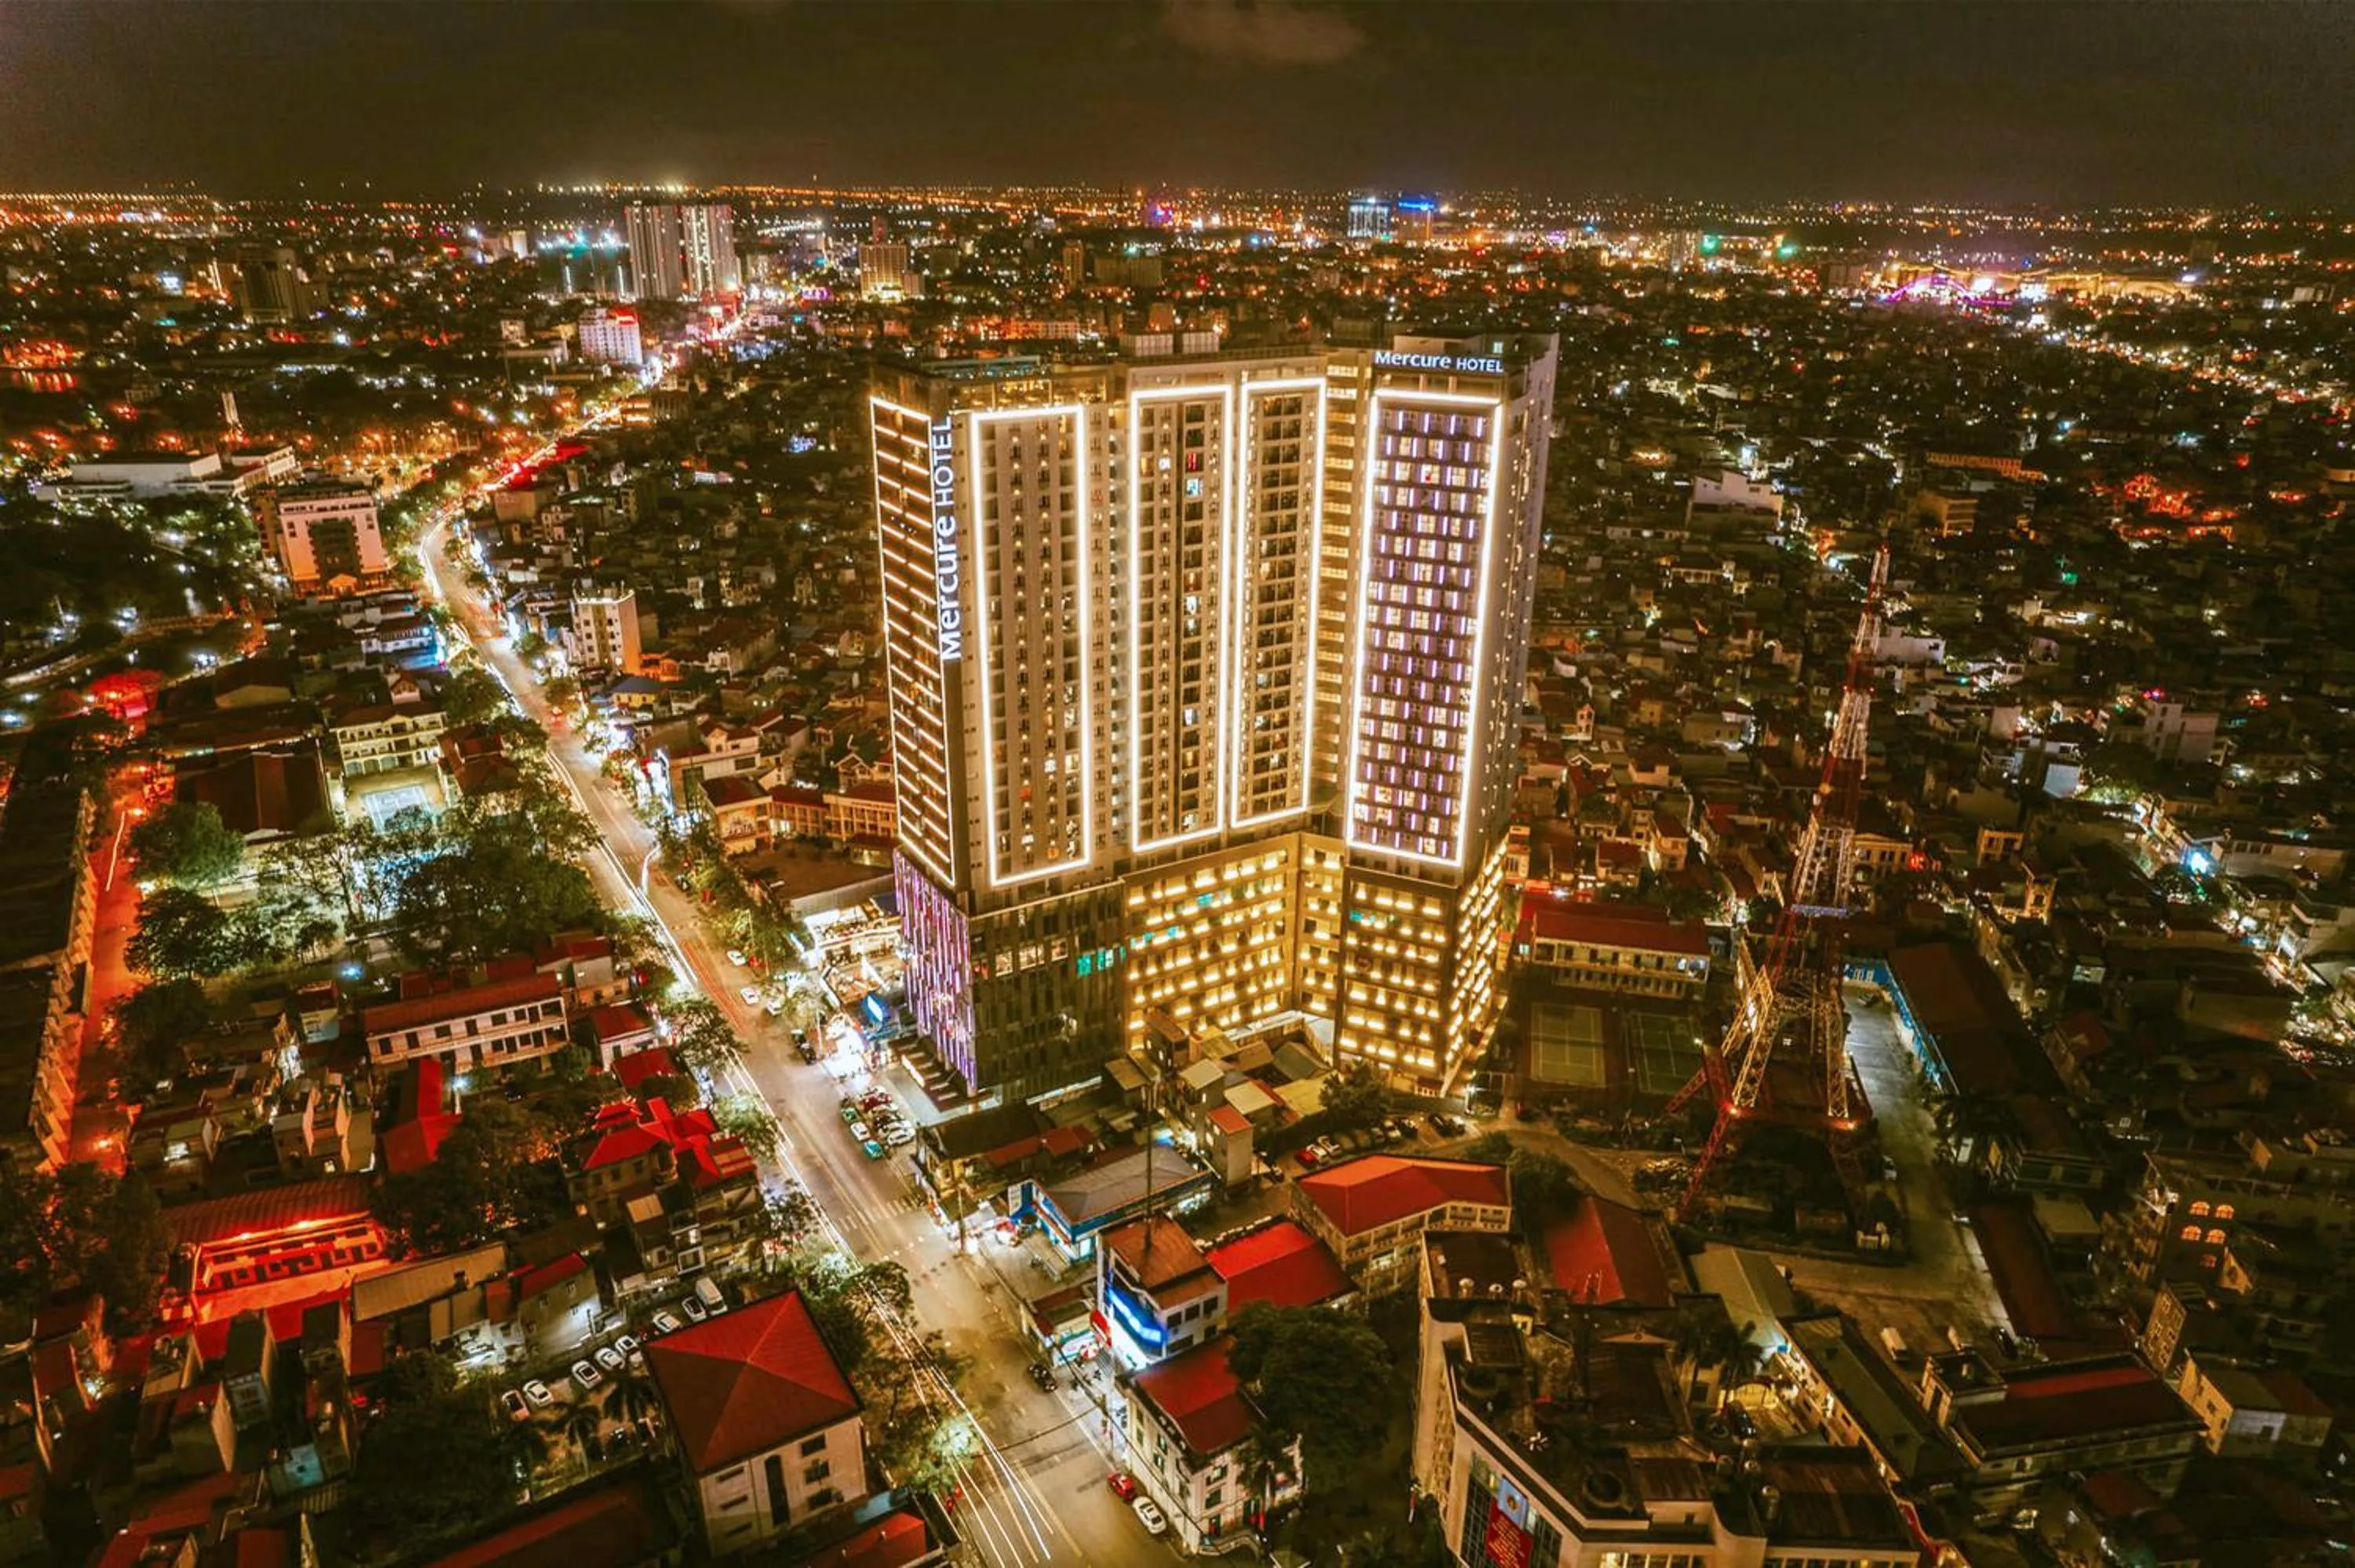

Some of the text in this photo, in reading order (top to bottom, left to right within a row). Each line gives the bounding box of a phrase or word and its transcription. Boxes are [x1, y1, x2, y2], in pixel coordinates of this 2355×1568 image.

[1375, 351, 1505, 373] Mercure HOTEL
[932, 415, 962, 661] Mercure HOTEL
